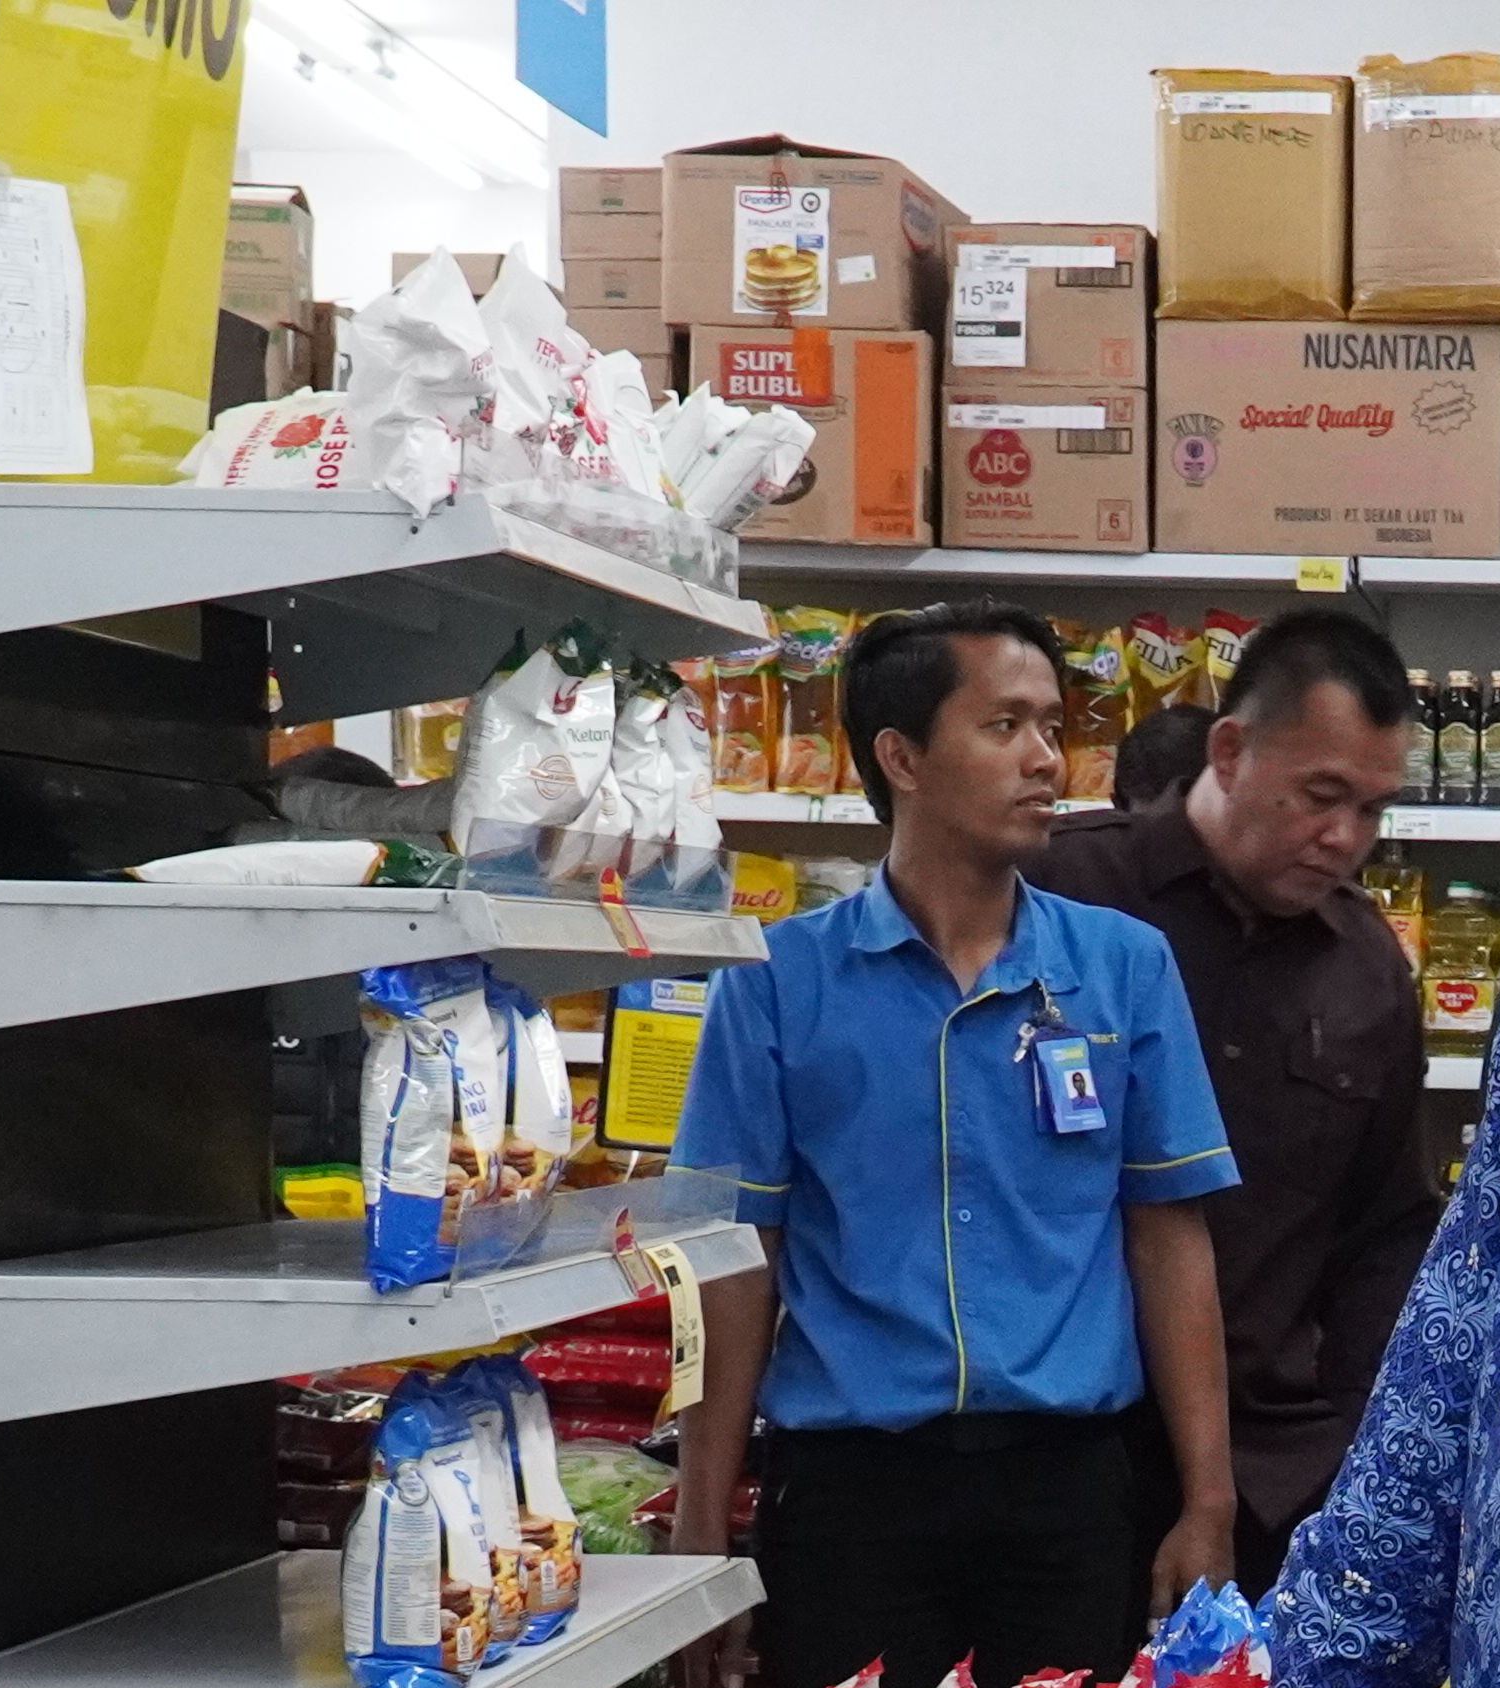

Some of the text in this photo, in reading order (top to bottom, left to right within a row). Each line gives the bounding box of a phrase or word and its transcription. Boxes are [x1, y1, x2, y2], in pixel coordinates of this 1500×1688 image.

[958, 280, 1014, 306] 15 324
[1303, 333, 1476, 371] NUSANTARA
[1239, 404, 1314, 431] Special
[1316, 403, 1395, 437] Quality
[973, 452, 1028, 476] ABC
[965, 491, 1033, 508] SAMBAL
[567, 728, 612, 743] Ketan
